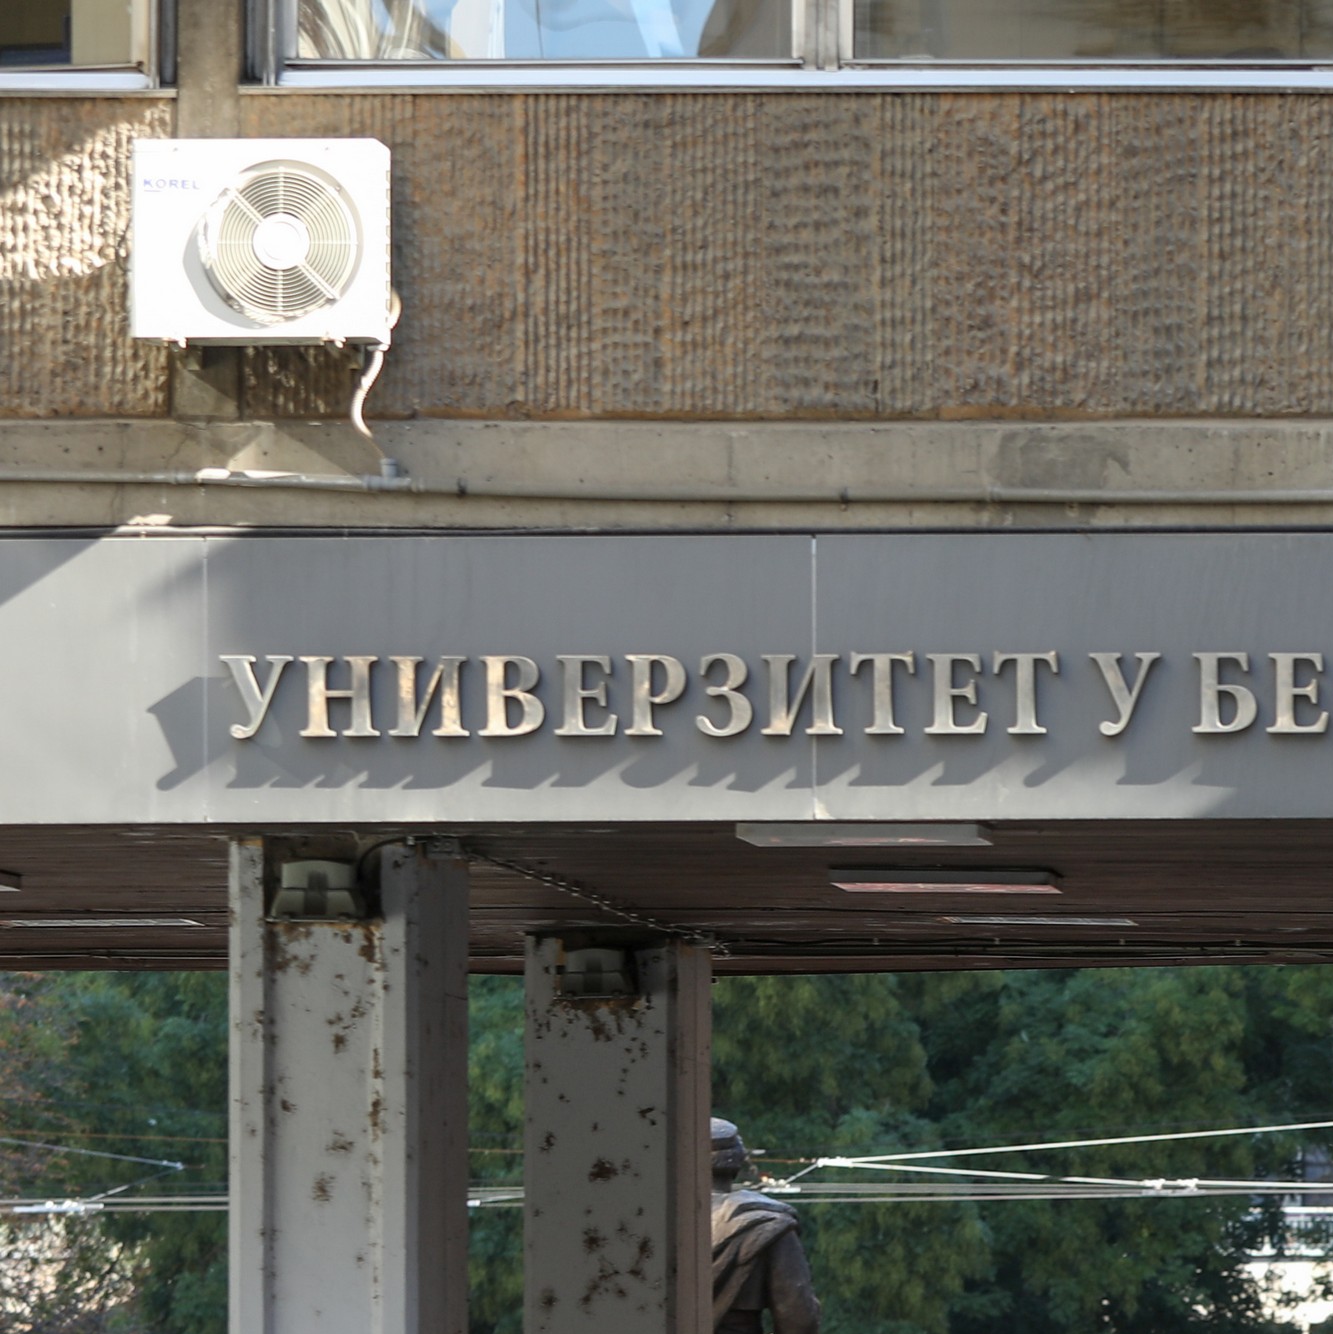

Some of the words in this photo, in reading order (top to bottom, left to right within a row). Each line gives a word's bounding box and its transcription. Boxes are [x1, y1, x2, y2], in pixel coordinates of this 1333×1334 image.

[143, 179, 200, 190] KOREL
[219, 650, 1060, 739] УНИВЕРЗИТЕТ
[1088, 651, 1161, 737] У
